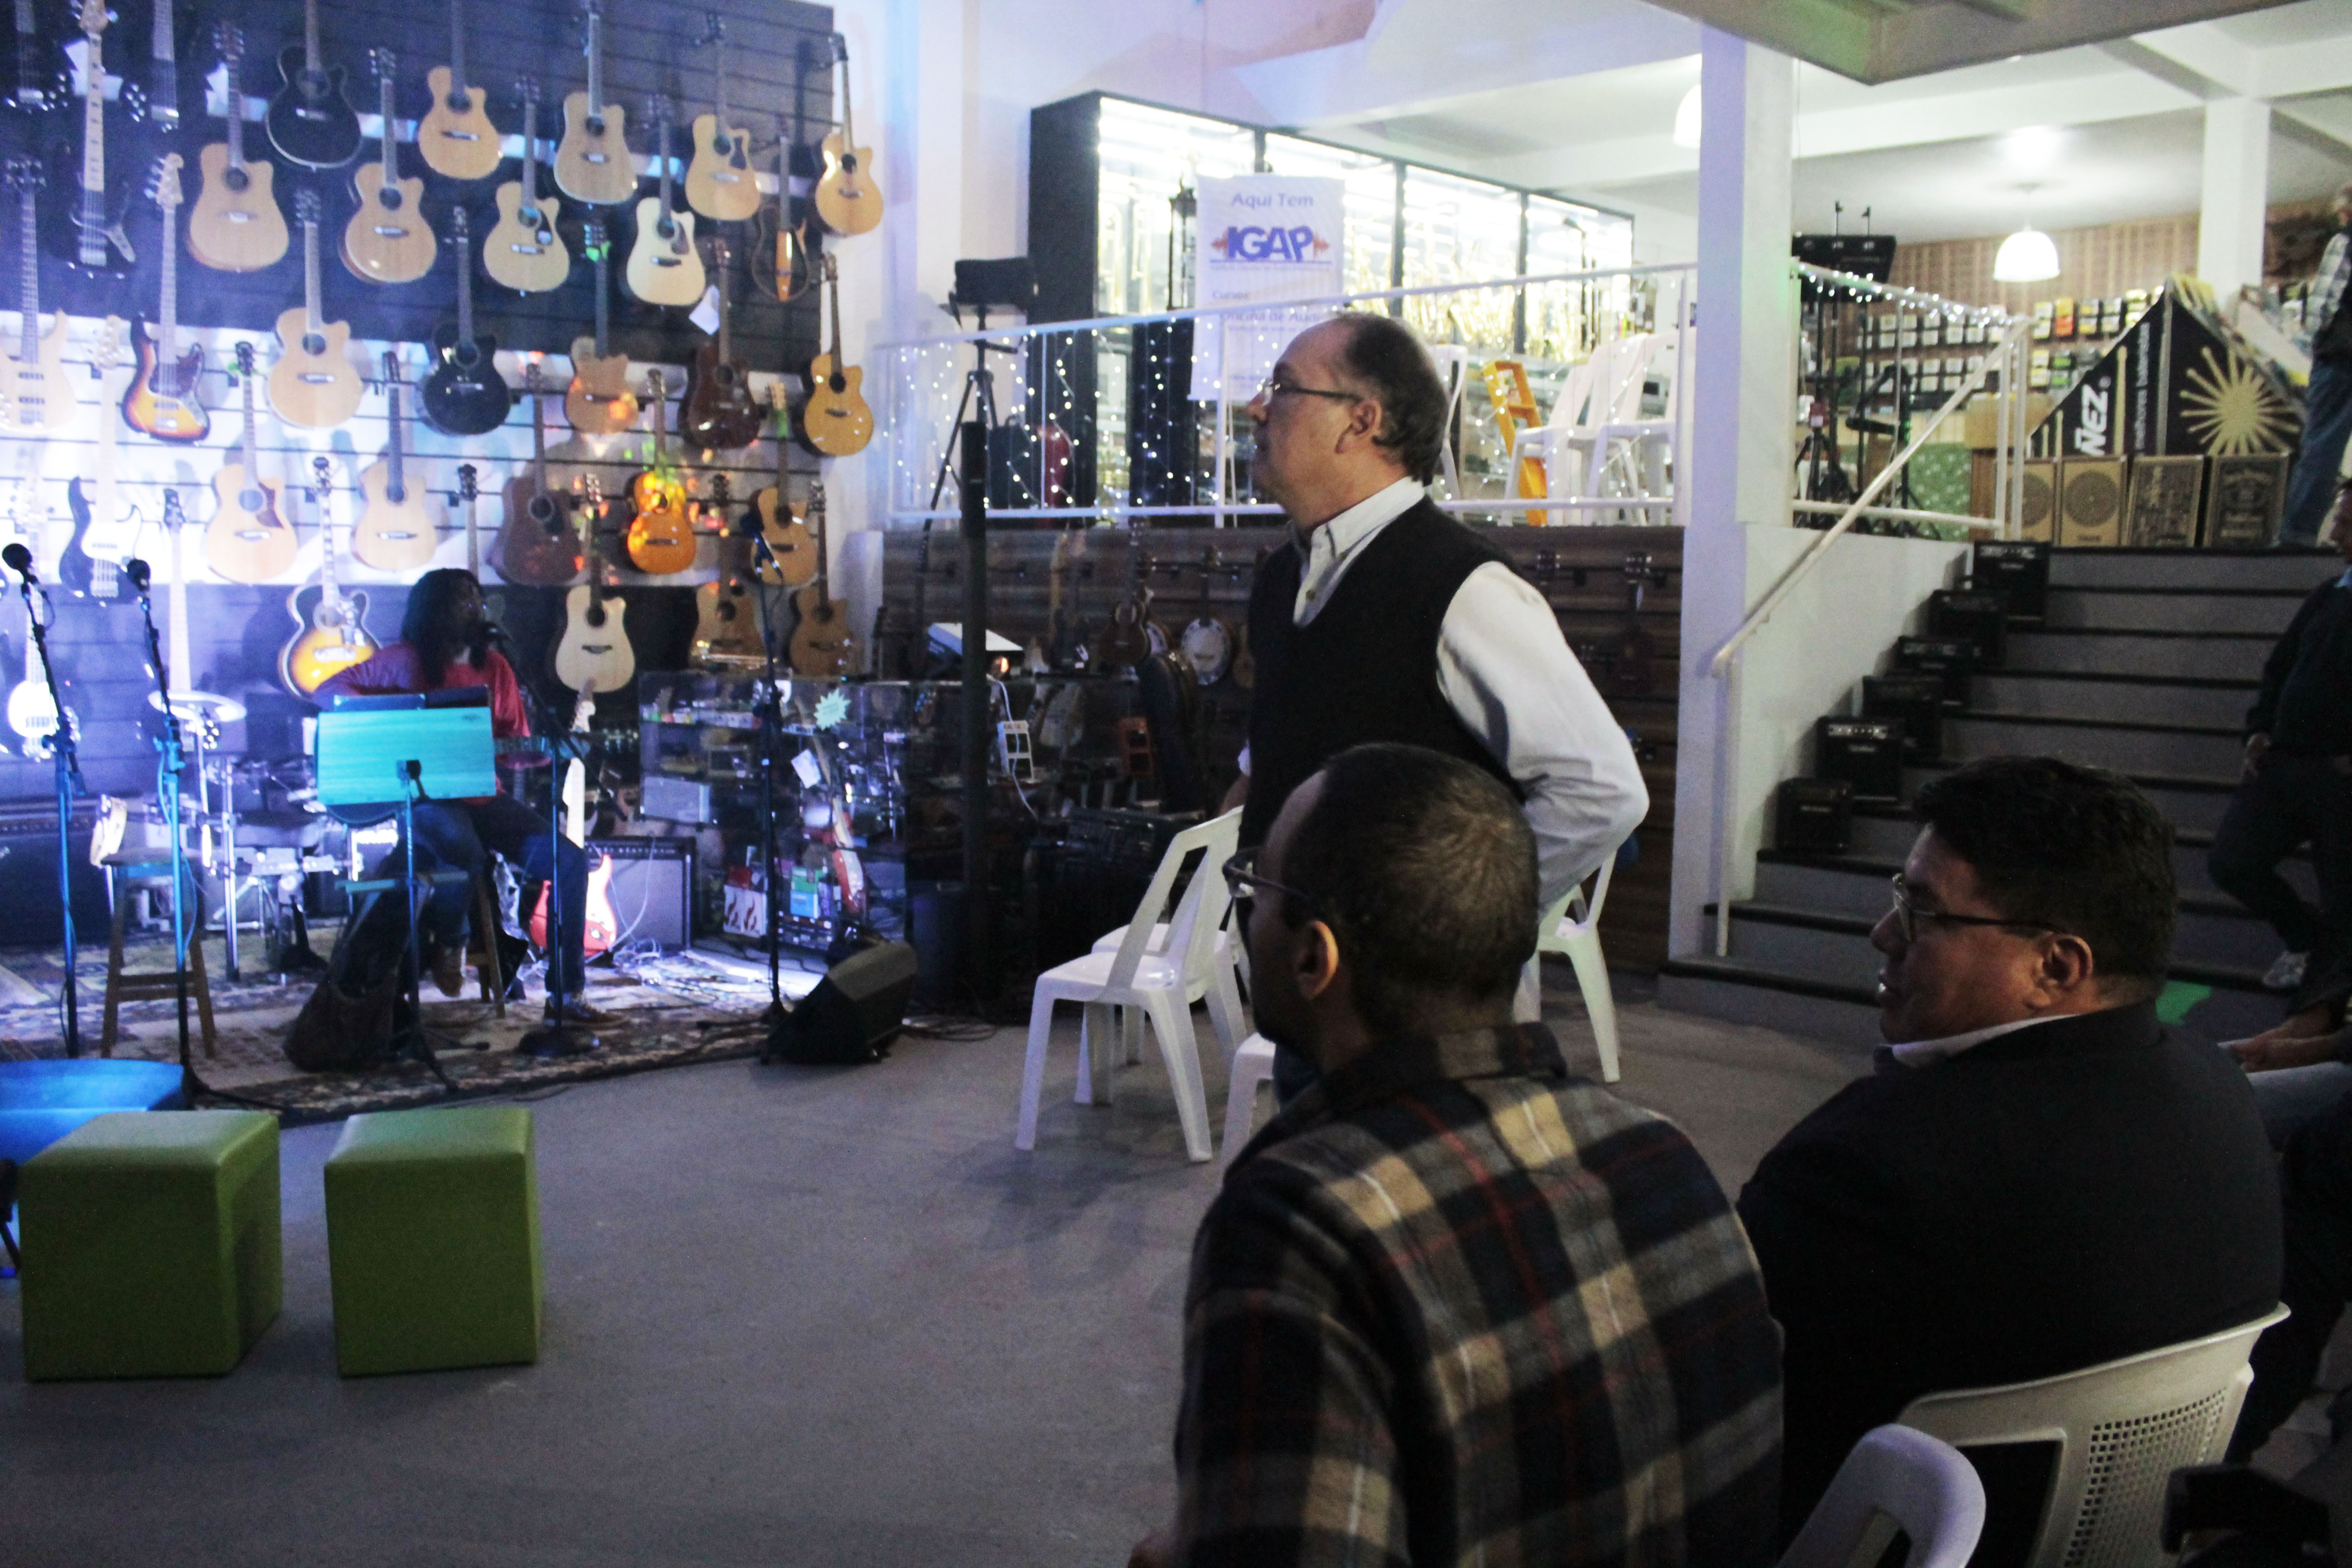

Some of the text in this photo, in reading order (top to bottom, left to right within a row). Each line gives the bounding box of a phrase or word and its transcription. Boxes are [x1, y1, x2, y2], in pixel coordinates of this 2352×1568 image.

[1231, 192, 1313, 210] Aqui Tem
[1228, 225, 1314, 263] IGAP
